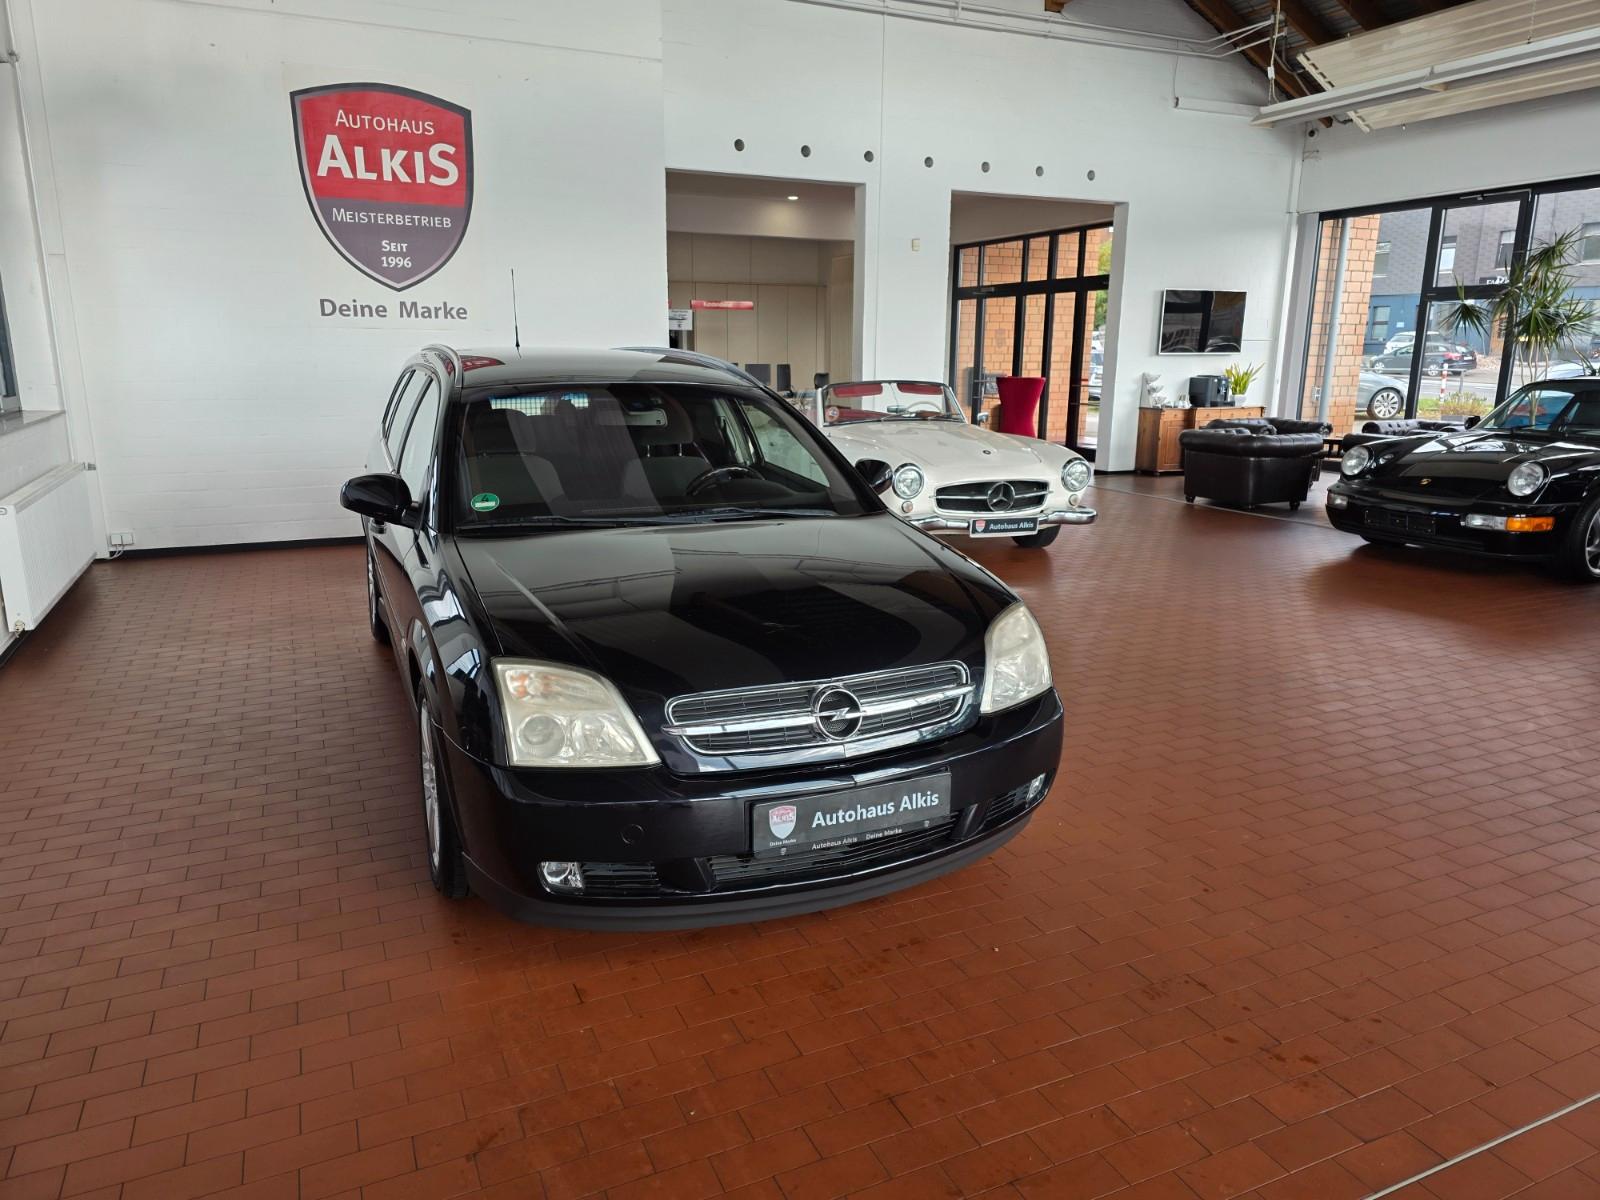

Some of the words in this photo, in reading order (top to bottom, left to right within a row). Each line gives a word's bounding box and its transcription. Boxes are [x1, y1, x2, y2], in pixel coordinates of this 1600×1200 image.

[335, 109, 434, 135] AUTOHAUS
[332, 207, 452, 228] MEISTERBETRIEB
[381, 256, 412, 269] 1996
[319, 298, 388, 318] Deine
[399, 300, 468, 320] Marke
[989, 522, 1018, 530] Autohaus
[1019, 521, 1034, 529] Alkis
[811, 802, 895, 828] Autohaus
[899, 791, 939, 812] Alkis
[811, 840, 842, 851] Autohaus
[865, 833, 883, 841] Deine
